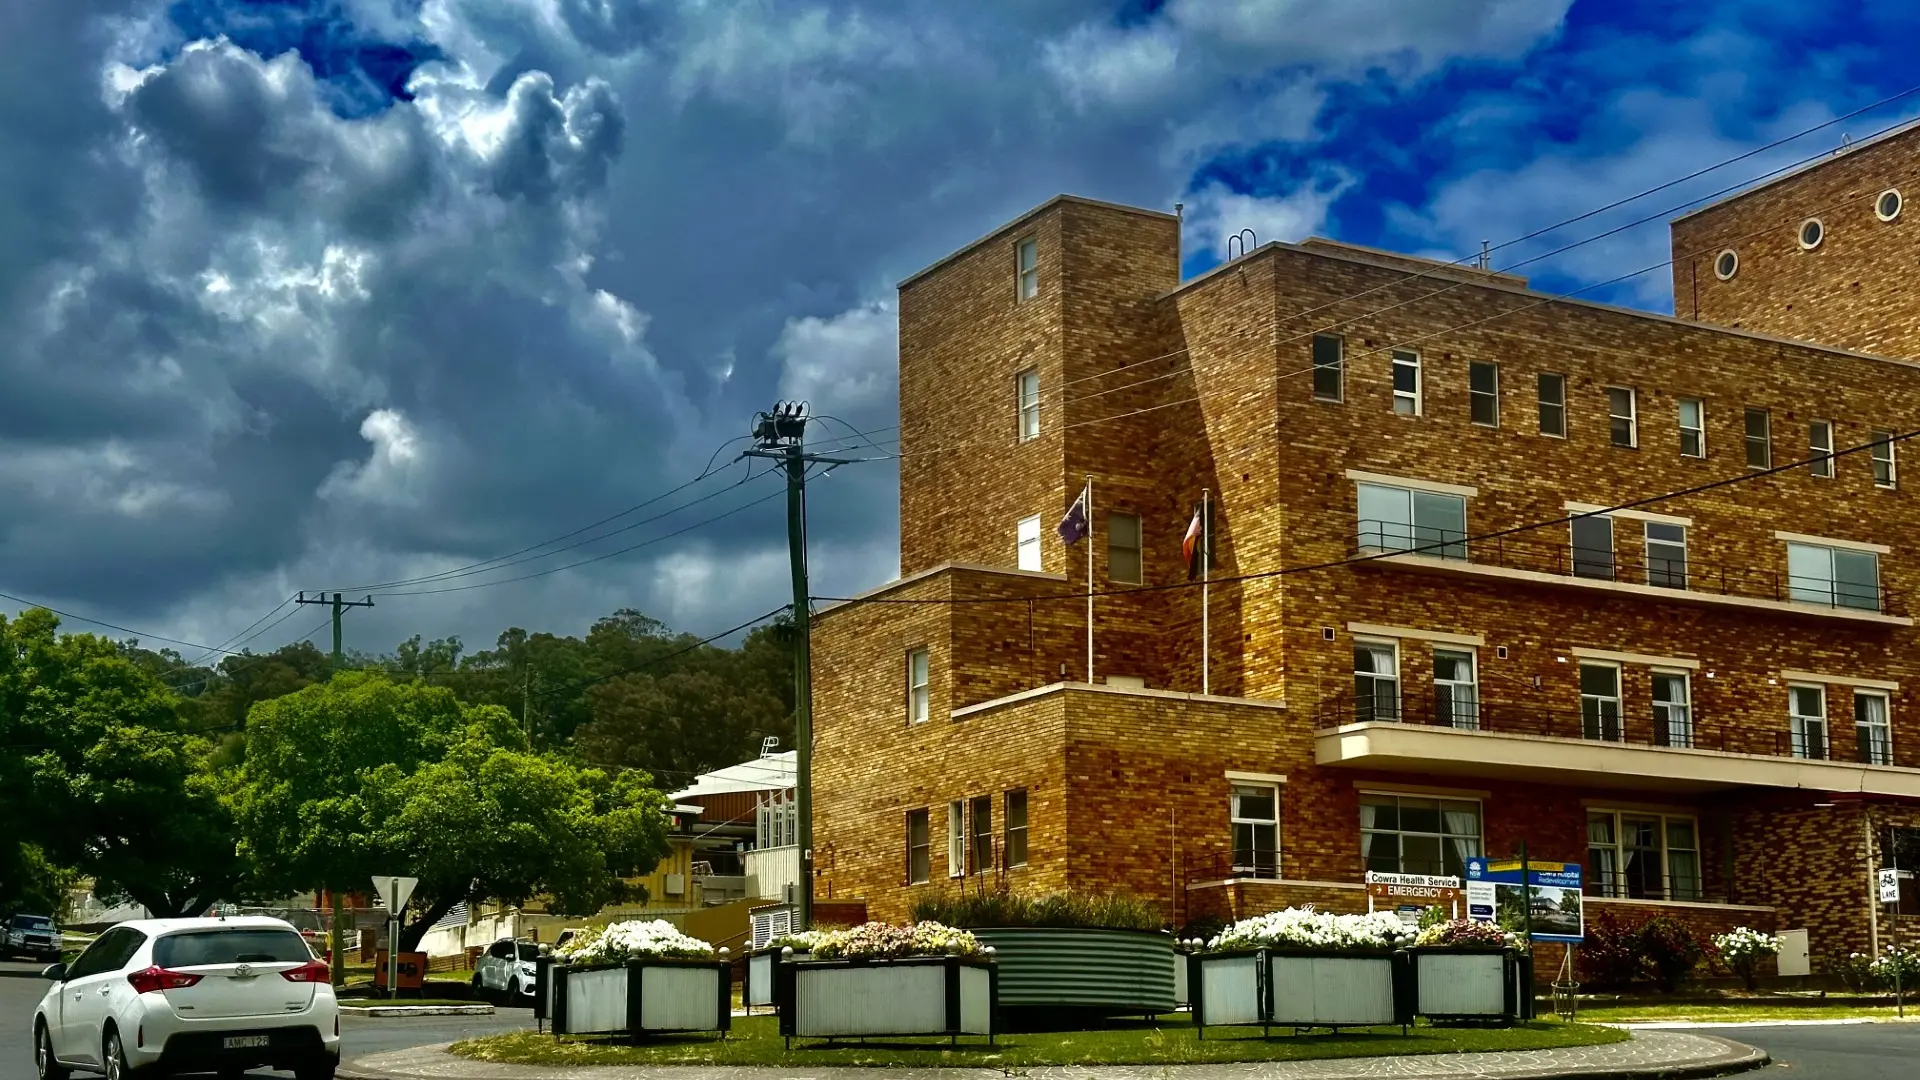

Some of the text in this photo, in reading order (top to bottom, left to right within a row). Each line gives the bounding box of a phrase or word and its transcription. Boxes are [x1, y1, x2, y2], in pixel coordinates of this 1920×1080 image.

[1371, 873, 1457, 887] Cowra Health Service
[1538, 876, 1579, 885] Redevelopment
[1387, 885, 1442, 898] EMERGENCY
[1882, 890, 1896, 899] LANE
